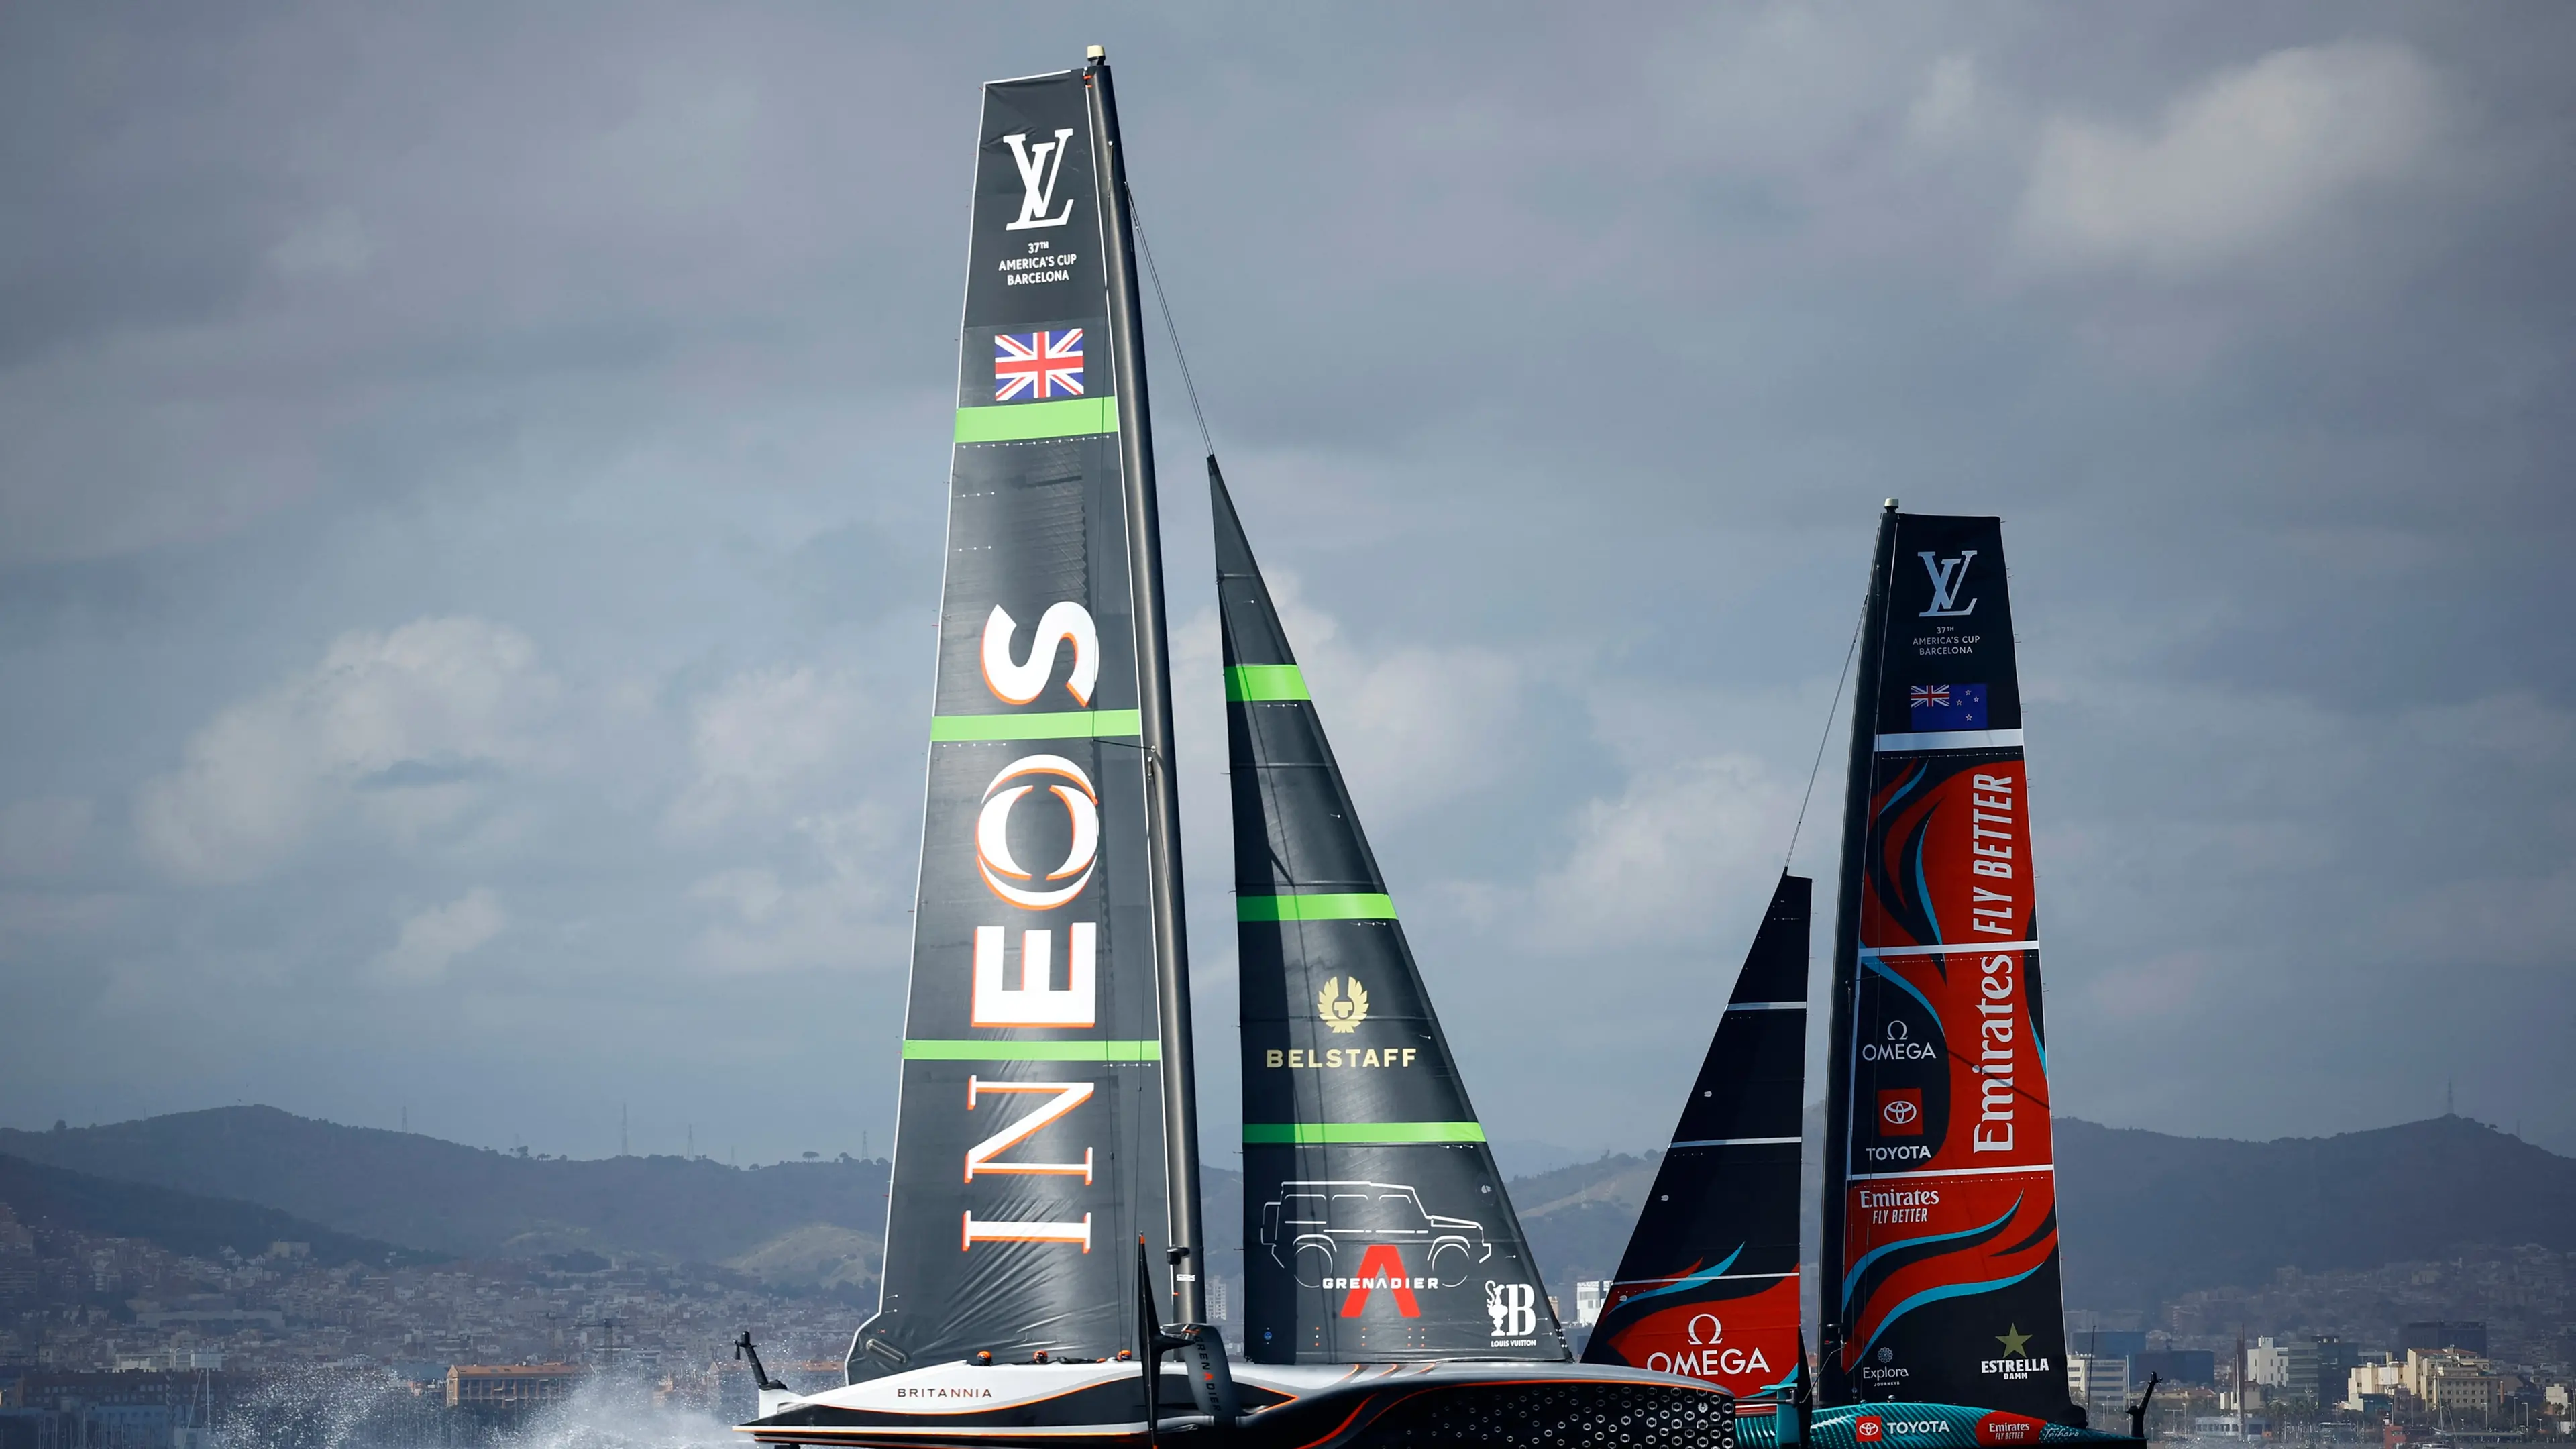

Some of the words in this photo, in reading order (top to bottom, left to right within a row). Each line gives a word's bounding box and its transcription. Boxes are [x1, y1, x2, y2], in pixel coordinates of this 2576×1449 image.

[1028, 241, 1049, 254] 37TH
[998, 256, 1055, 271] AMERICA'S
[1057, 254, 1077, 265] CUP
[1007, 270, 1069, 286] BARCELONA
[1936, 626, 1954, 634] 37TH
[1913, 637, 1960, 645] AMERICA'S
[1919, 646, 1973, 655] BARCELONA
[1973, 773, 2012, 879] BETTER
[1973, 886, 2012, 935] FLY
[962, 601, 1099, 1253] INEOS
[1266, 1048, 1417, 1068] BELSTAFF
[1862, 1042, 1936, 1061] OMEGA
[1972, 954, 2014, 1153] Emirates
[1866, 1146, 1931, 1161] TOYOTA
[1860, 1189, 1939, 1208] Emirates
[1872, 1209, 1890, 1224] FLY
[1892, 1208, 1927, 1223] BETTER
[1647, 1347, 1770, 1376] OMEGA
[1981, 1358, 2049, 1373] ESTRELLA
[1863, 1366, 1909, 1381] Explora
[897, 1388, 992, 1398] BRITANNIA
[1888, 1421, 1949, 1434] TOYOTA
[1989, 1422, 2030, 1432] Emirates
[2043, 1427, 2080, 1440] Taihoro
[2005, 1432, 2024, 1440] BETTER
